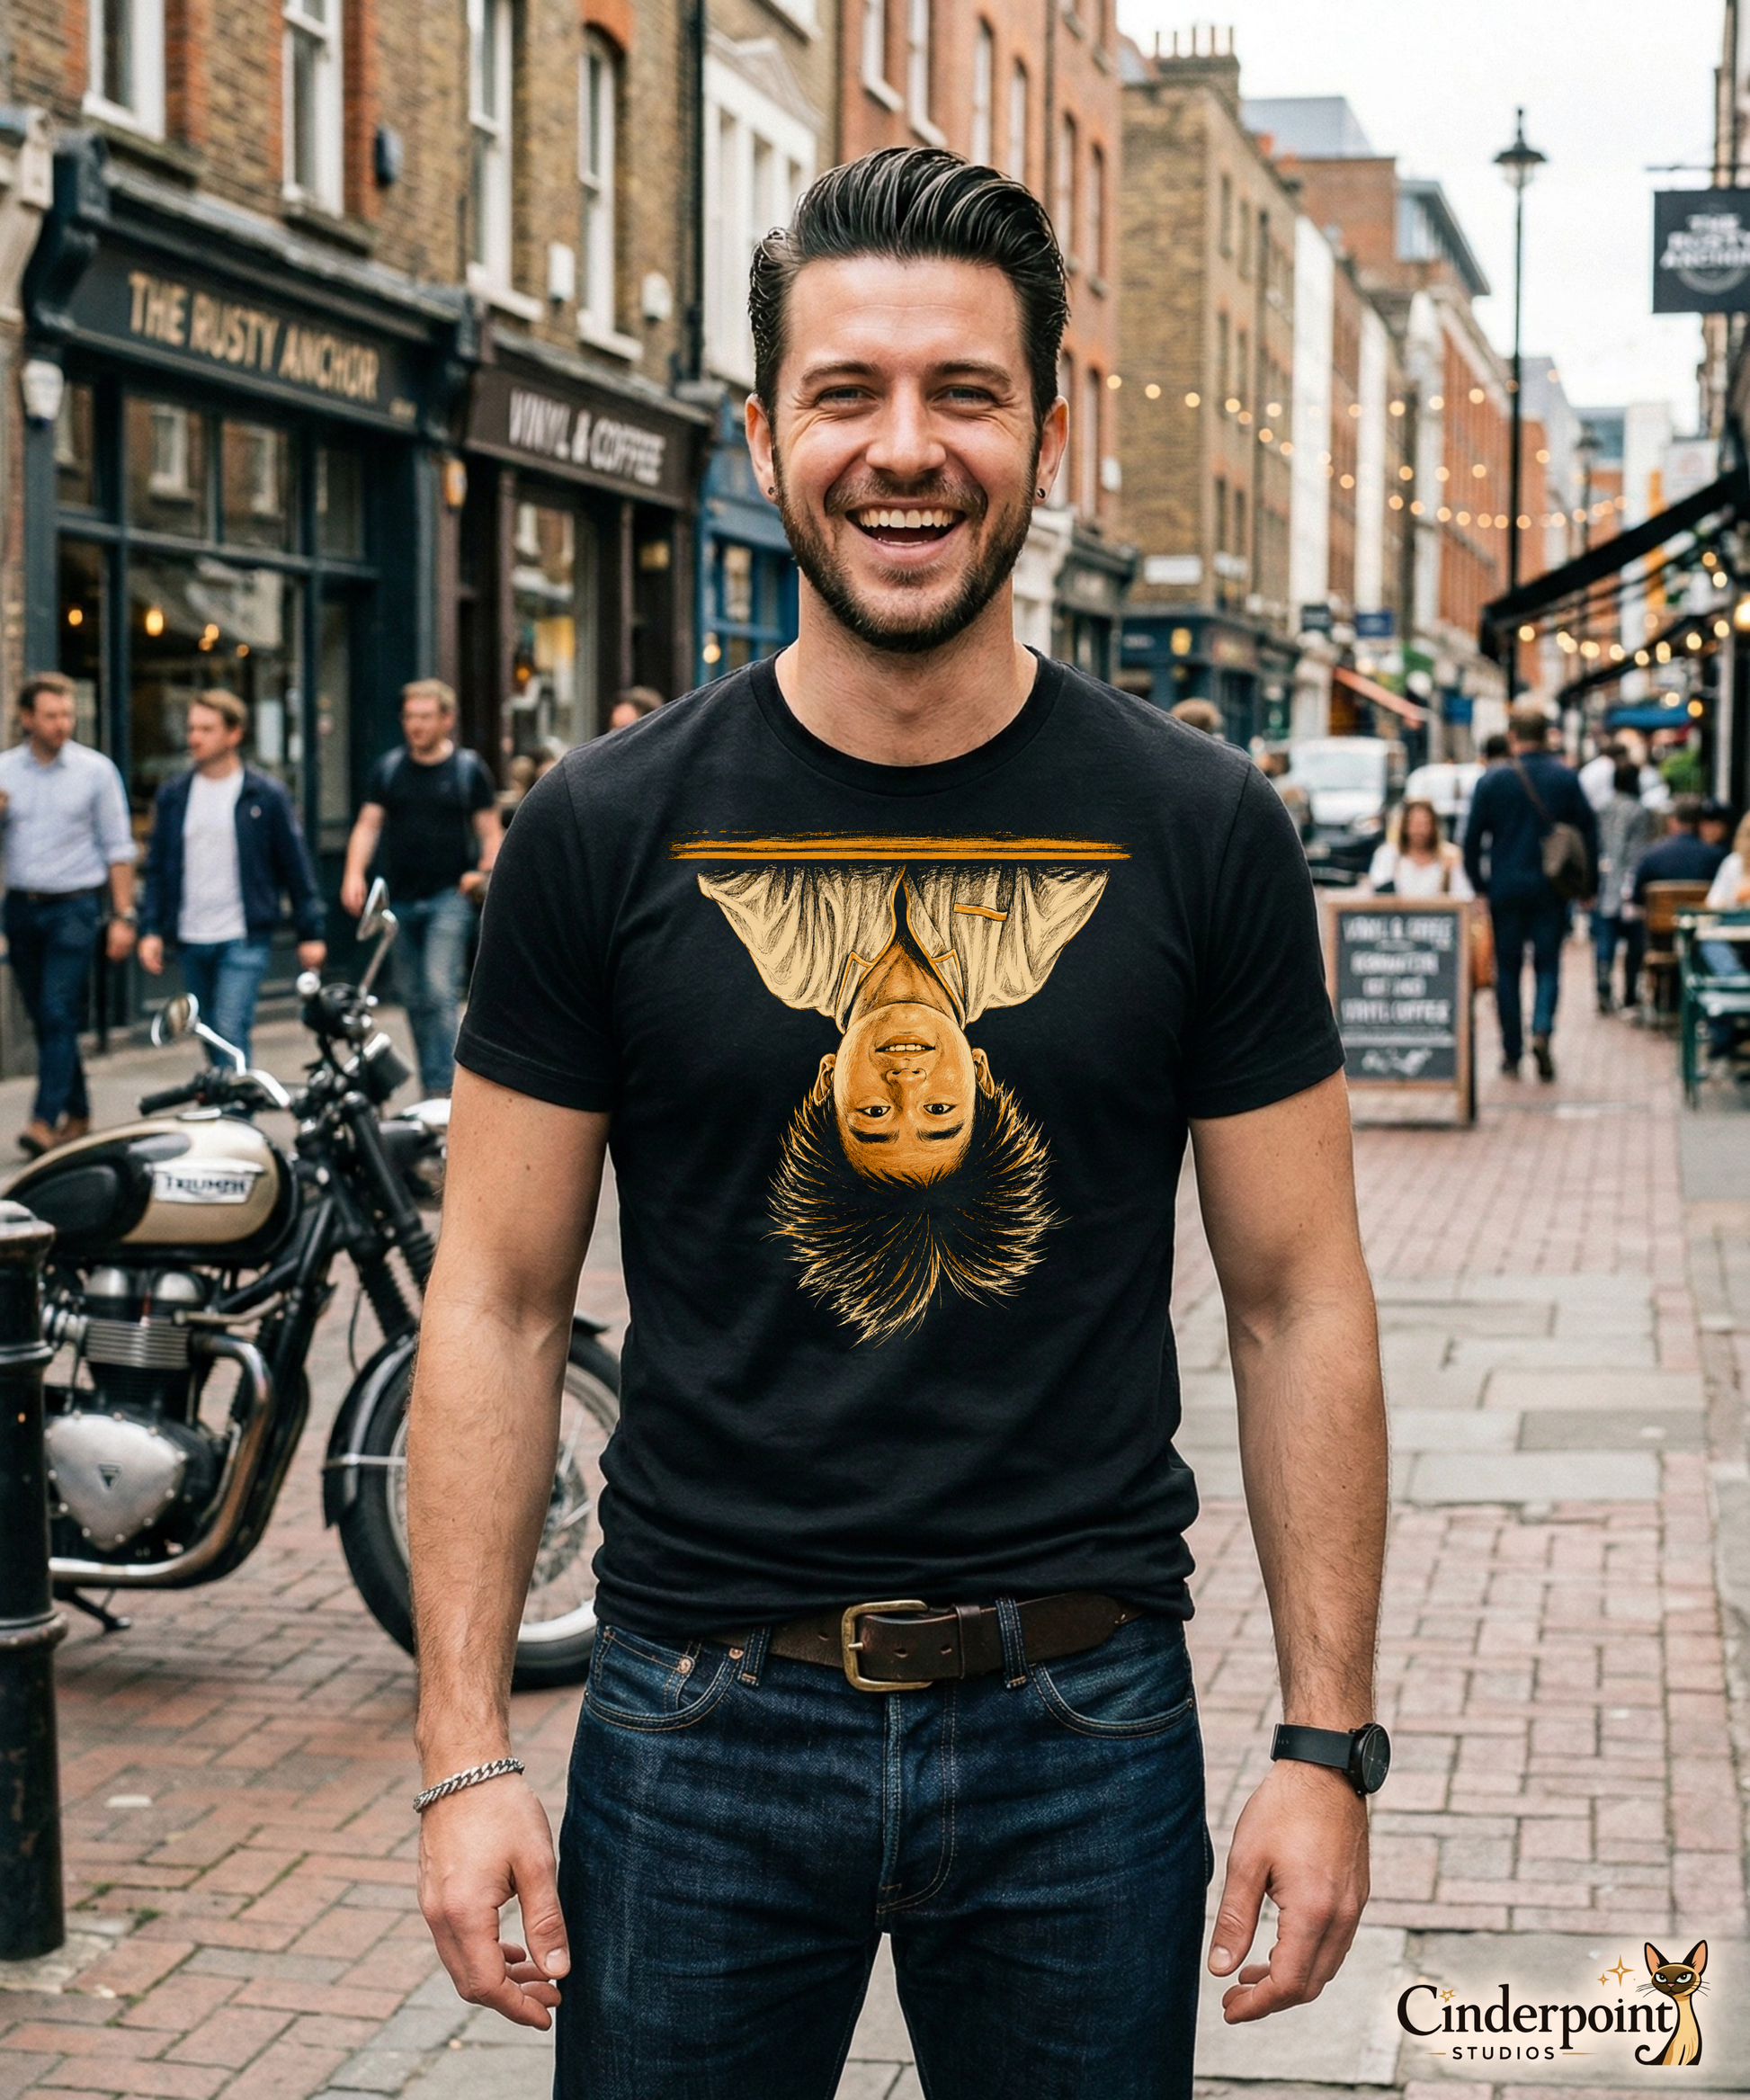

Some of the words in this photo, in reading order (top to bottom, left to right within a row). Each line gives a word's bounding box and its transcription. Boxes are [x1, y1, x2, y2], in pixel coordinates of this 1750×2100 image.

[129, 271, 188, 348] THE
[189, 290, 280, 372] RUSTY
[277, 322, 379, 402] ANCHOR
[509, 386, 571, 460] VINYL
[590, 416, 666, 487] COFFEE
[165, 1175, 246, 1193] TRIUMPH
